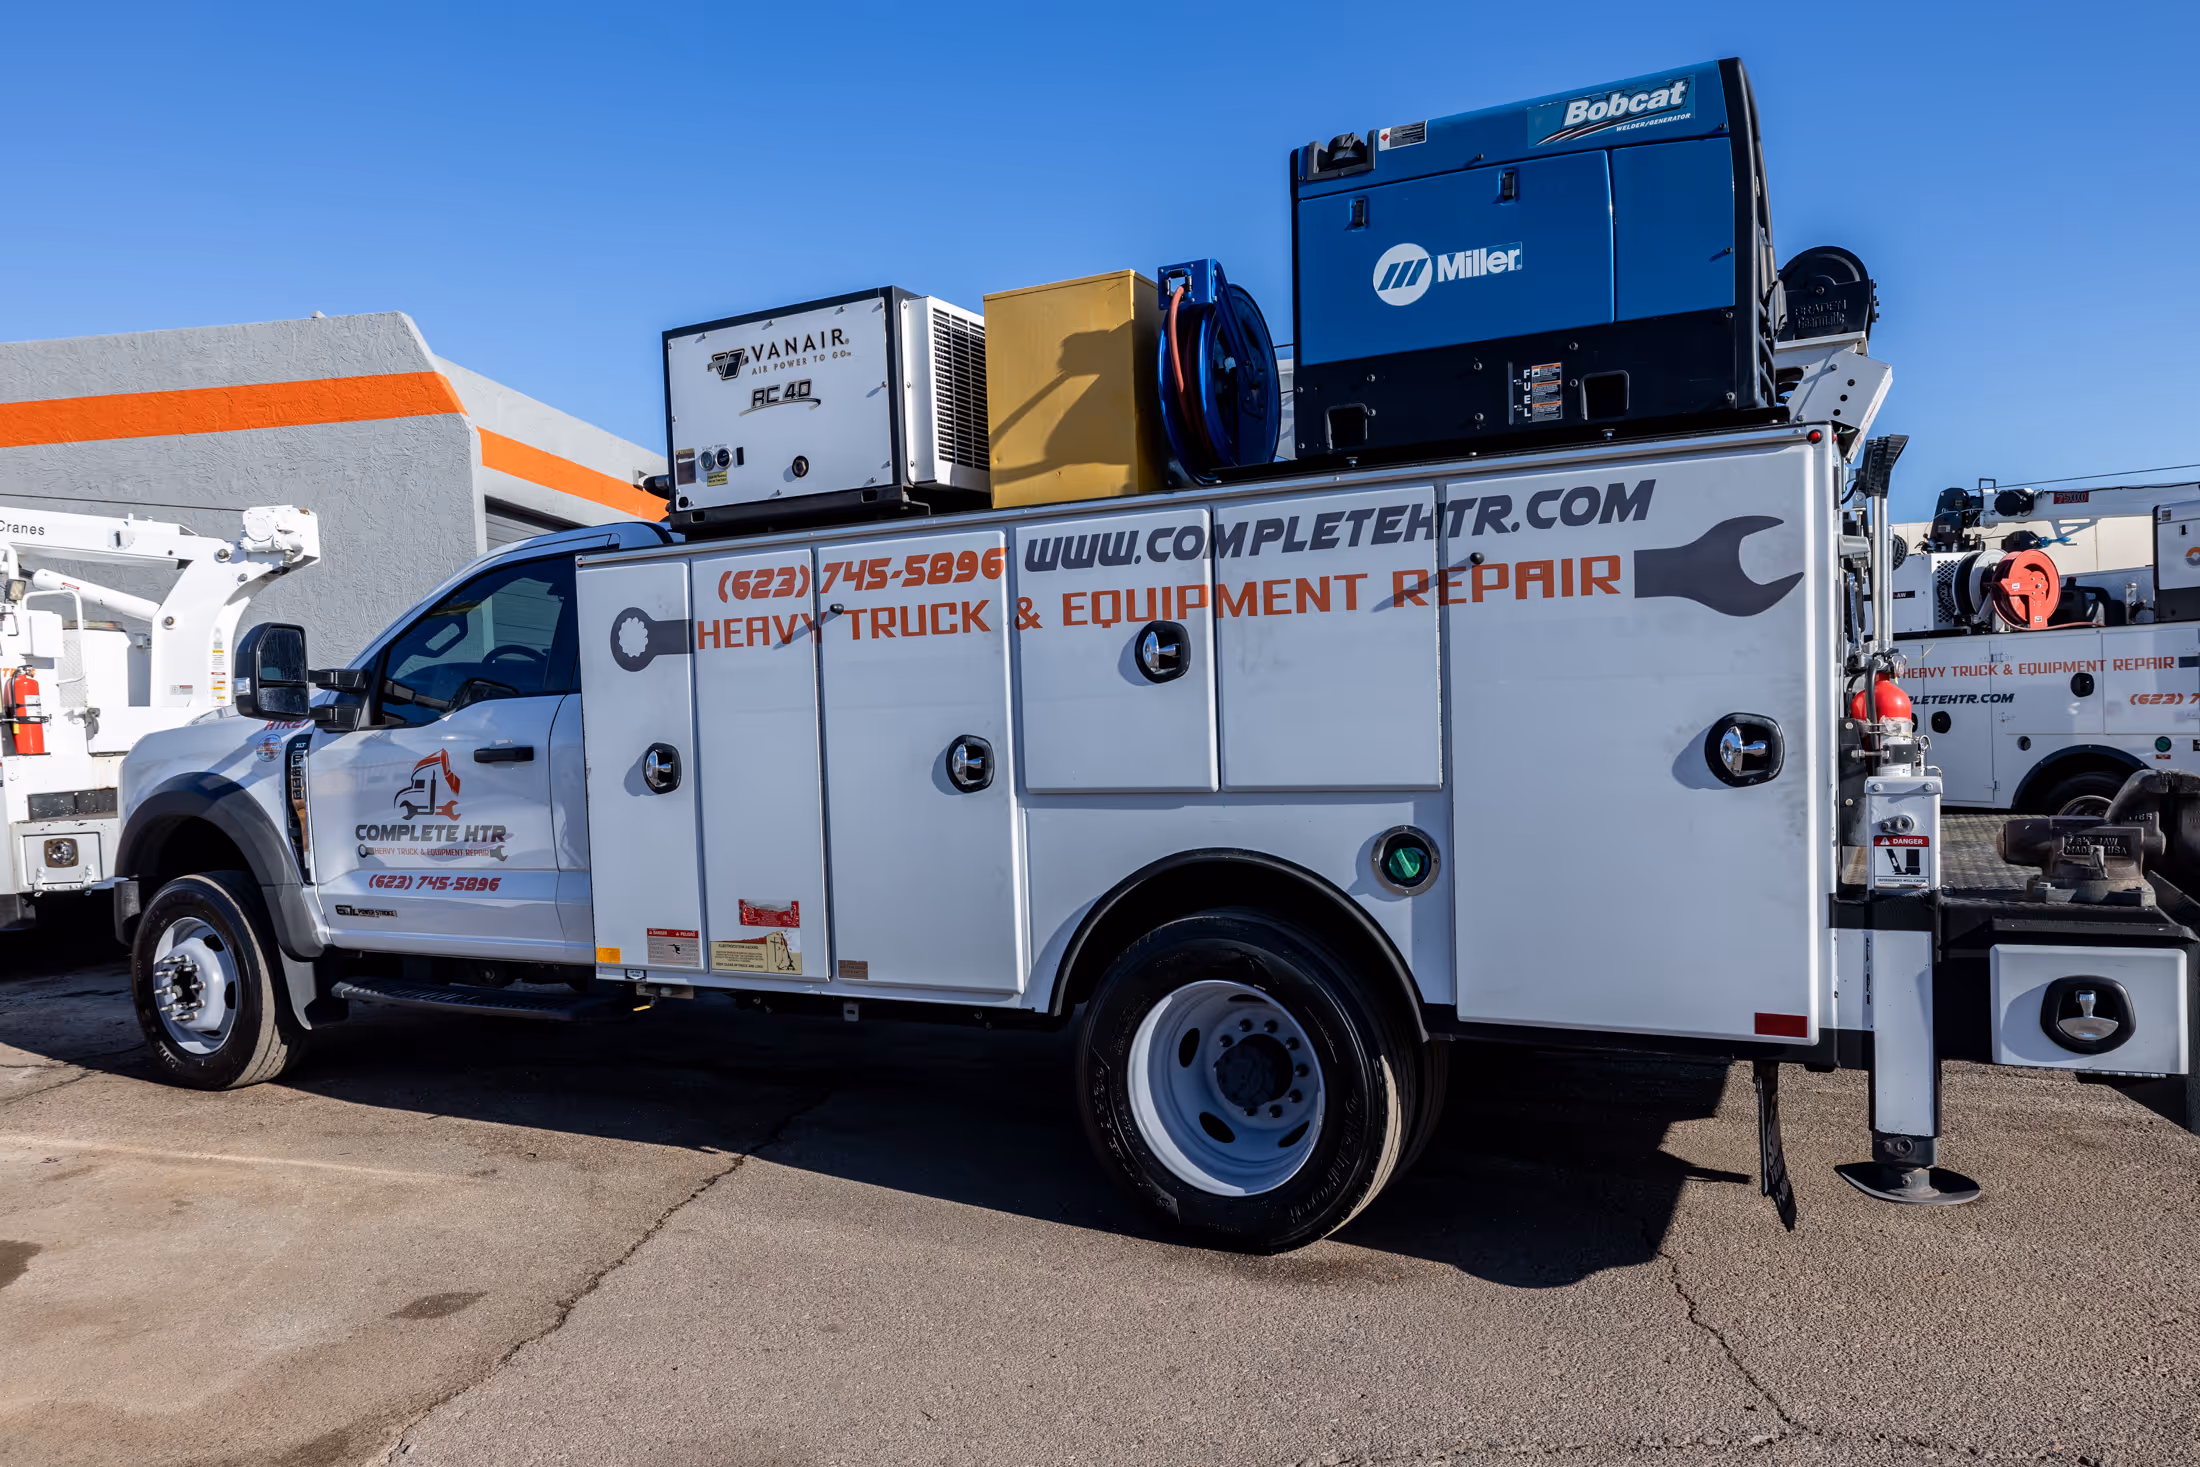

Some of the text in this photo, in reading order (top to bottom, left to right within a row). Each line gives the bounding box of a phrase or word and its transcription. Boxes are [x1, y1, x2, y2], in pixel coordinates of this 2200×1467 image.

[1563, 79, 1687, 127] Bobcat
[1616, 112, 1691, 132] WELDER/GENERATOR
[1437, 247, 1521, 283] Miller
[751, 328, 846, 362] VANAIR
[751, 365, 768, 375] AIR
[774, 357, 807, 371] POWER
[813, 354, 825, 363] TO
[1025, 479, 1656, 572] WWW.COMPLETEHTR.COM
[718, 547, 1010, 603] (623) 745-5896
[697, 555, 1621, 649] HEAVY TRUCK & EQUIPMENT REPAIR
[1902, 656, 2175, 679] HEAVY TRUCK & EQUIPMENT REPAIR
[2130, 692, 2185, 706] (623)
[355, 824, 507, 843] COMPLETE HTR
[374, 847, 395, 855] HEAVY
[397, 848, 419, 856] TRUCK
[427, 848, 464, 857] EQUIPMENT
[465, 848, 490, 857] REPAIR
[369, 874, 502, 892] (623) 745-5896
